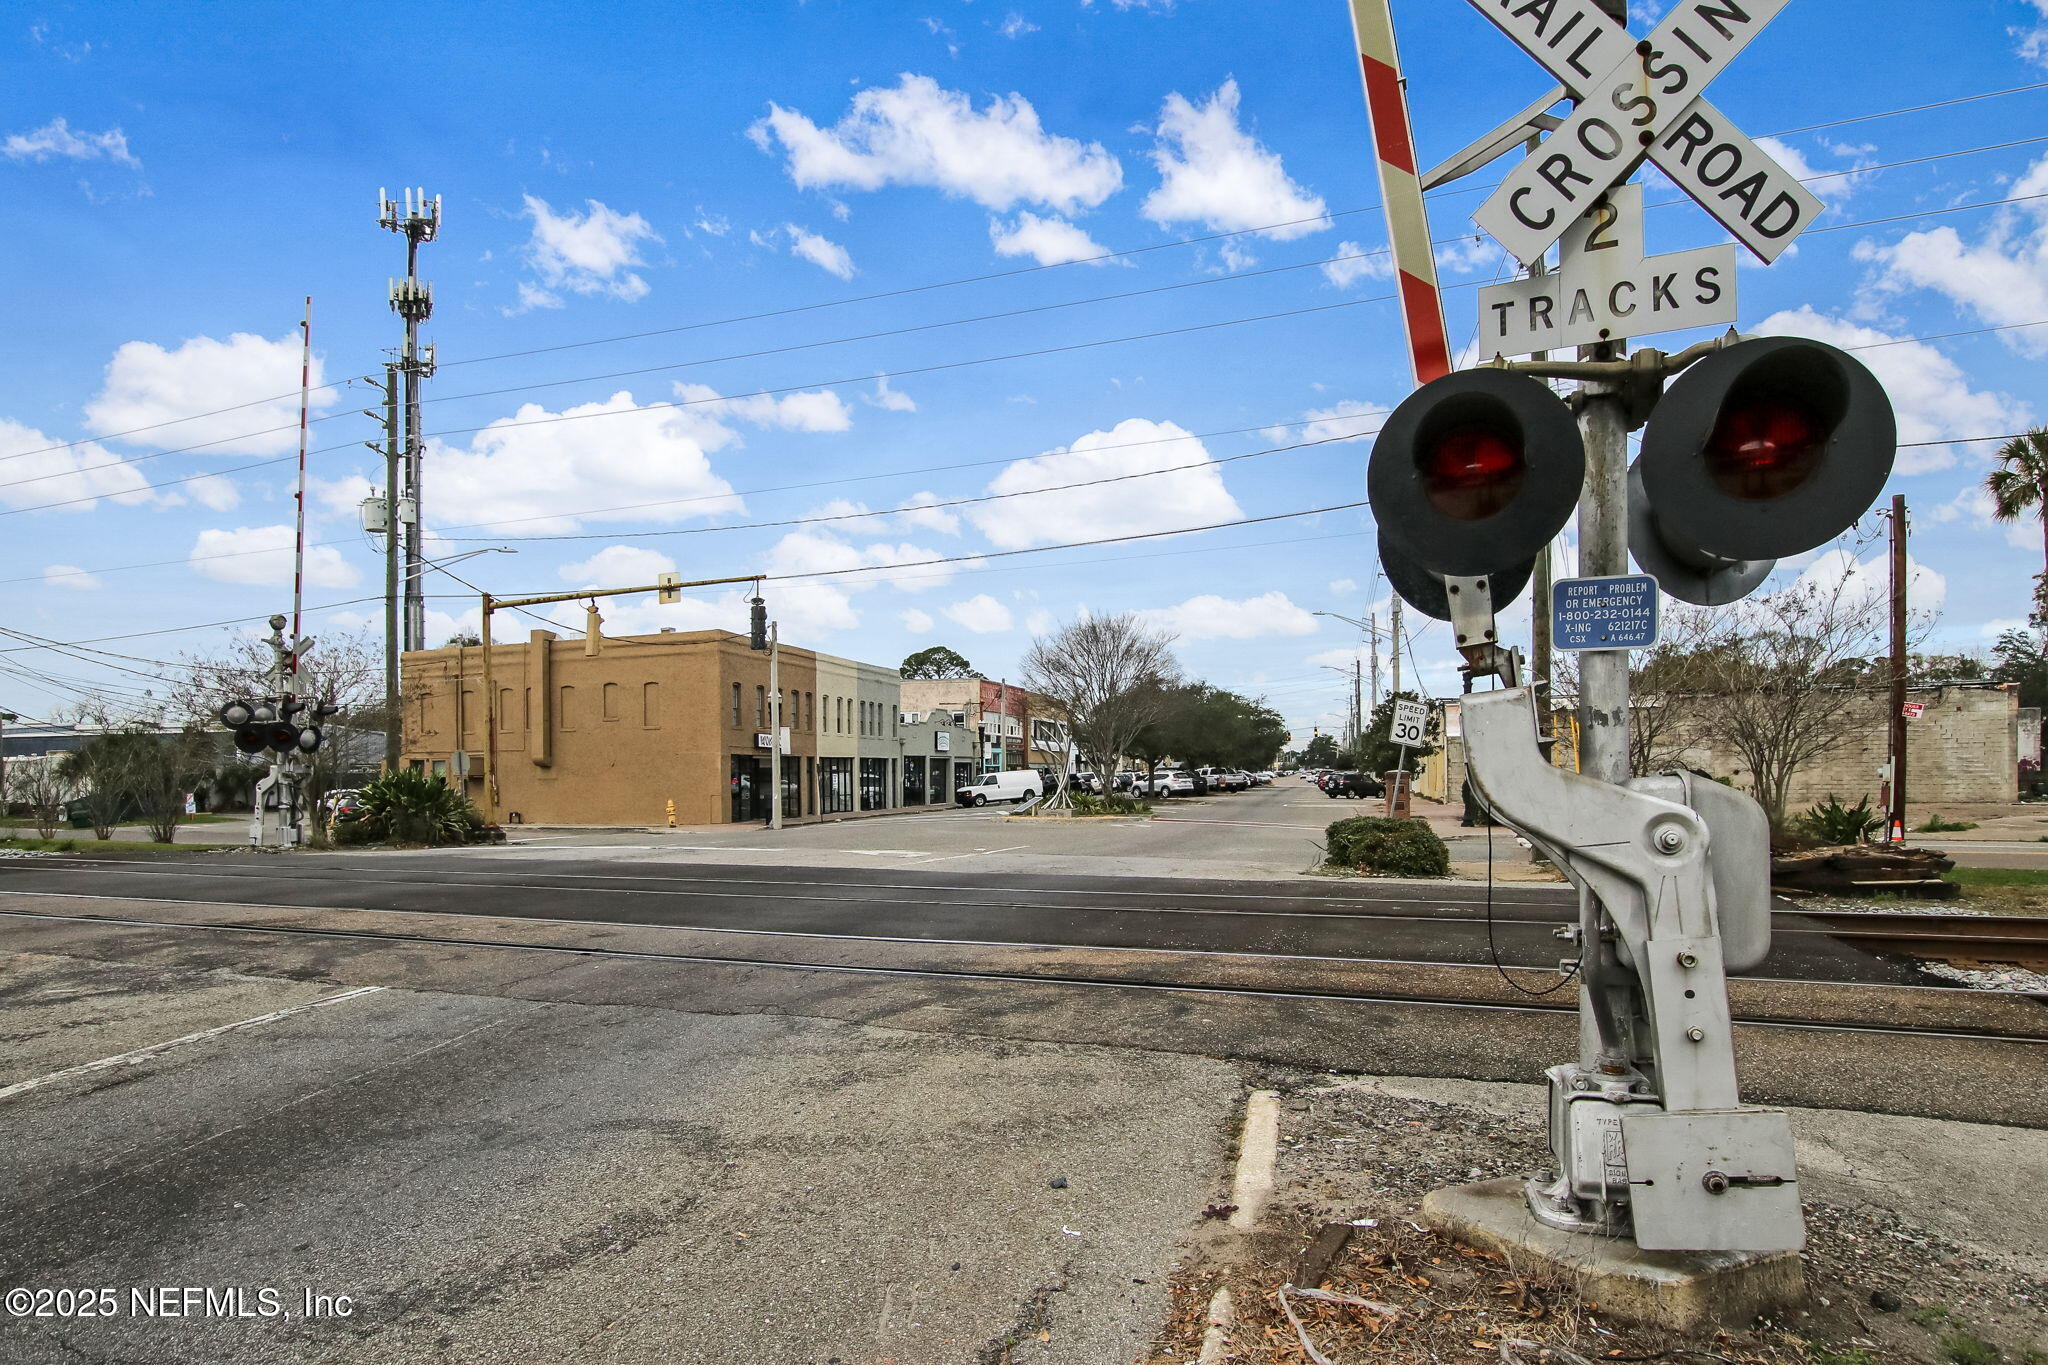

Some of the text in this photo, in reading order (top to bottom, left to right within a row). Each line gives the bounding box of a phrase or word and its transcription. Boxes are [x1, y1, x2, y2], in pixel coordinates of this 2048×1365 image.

[1500, 0, 1603, 79] AIL
[1662, 111, 1800, 239] ROAD
[1584, 203, 1618, 252] 2
[1491, 266, 1721, 337] TRACKS
[1568, 582, 1647, 596] REPORT PROBLEM
[1565, 595, 1643, 609] OR EMERGENCY
[1559, 607, 1650, 621] 1-800-232-0144
[1565, 623, 1592, 633] X-ING
[1569, 632, 1645, 643] CSX A 646.47
[1398, 703, 1425, 715] SPEED
[1399, 713, 1420, 723] LIMIT
[1395, 723, 1420, 741] 30
[1596, 1118, 1618, 1126] TYPE
